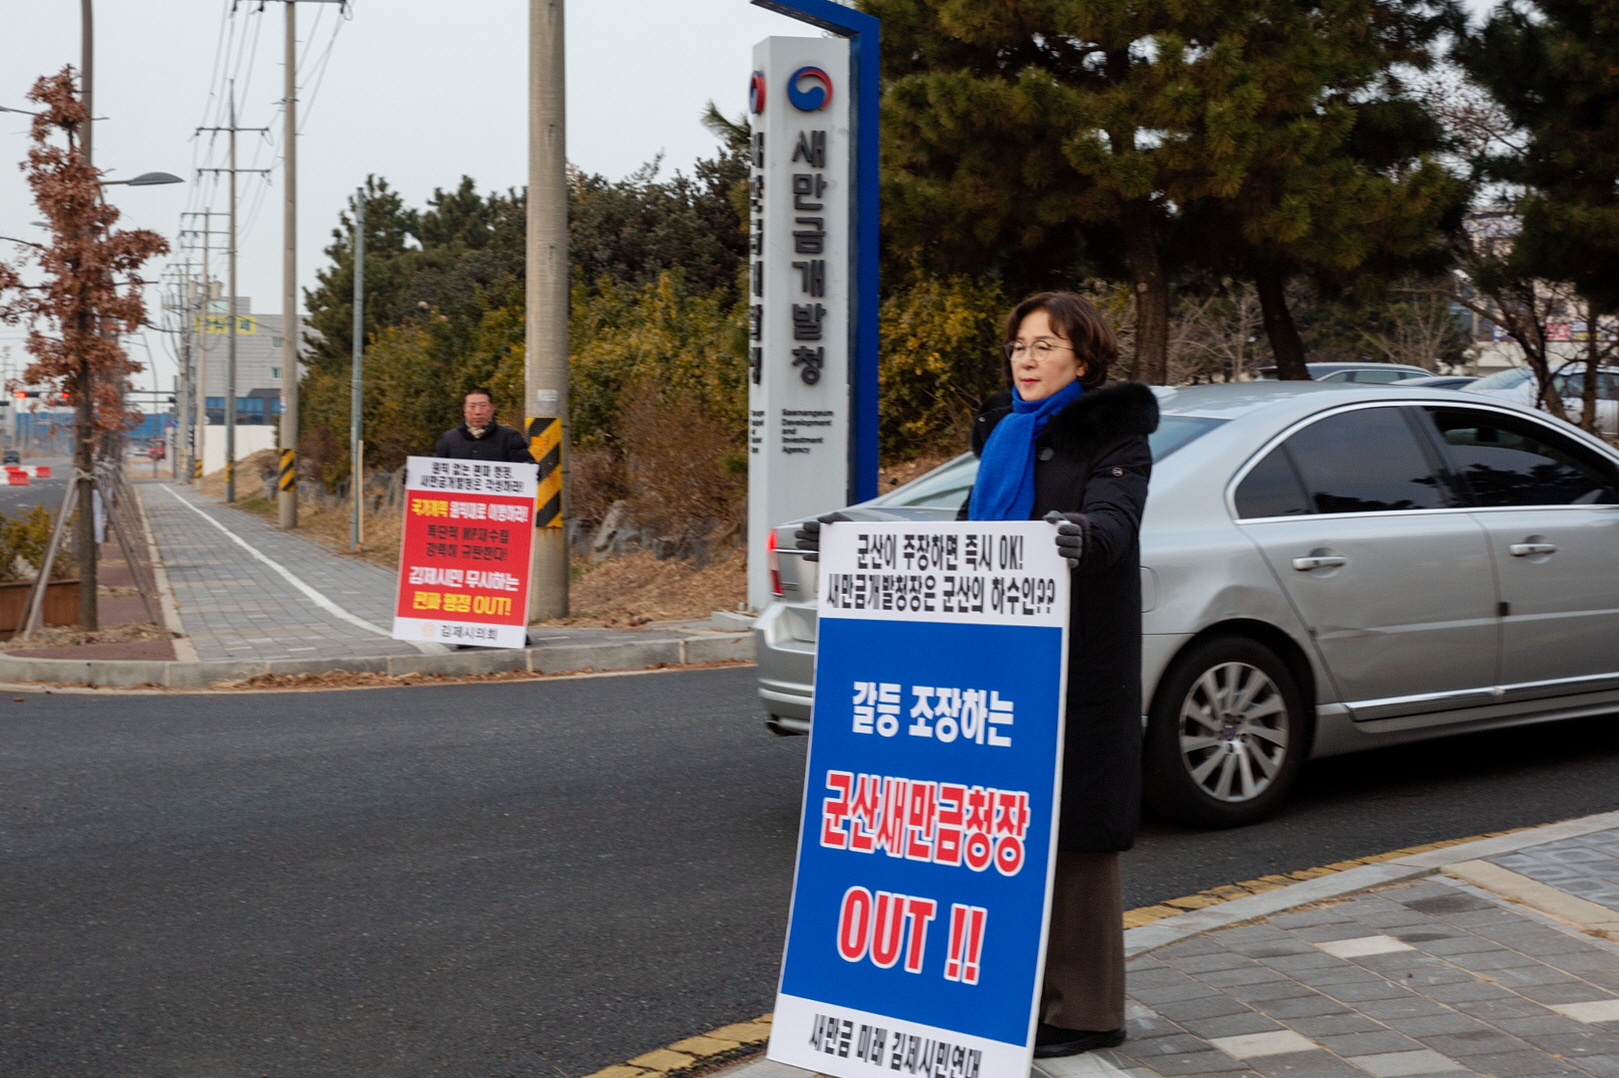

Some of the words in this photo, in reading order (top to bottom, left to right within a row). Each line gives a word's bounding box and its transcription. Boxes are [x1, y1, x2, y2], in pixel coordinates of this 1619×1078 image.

[791, 130, 827, 386] 새만금개발청
[782, 446, 811, 454] Agency
[857, 534, 897, 569] 군산이
[903, 534, 958, 571] 주장하면
[965, 535, 992, 571] 즉시
[999, 535, 1024, 570] OK!
[409, 566, 463, 587] 김제시민
[466, 571, 520, 591] 무시하는
[827, 574, 936, 612] 새만금개발청장은
[942, 576, 985, 614] 군산의
[991, 577, 1056, 615] 하수인??
[443, 593, 471, 612] 행정
[473, 596, 512, 615] OUT!
[441, 625, 498, 640] 김제시의회
[852, 681, 901, 738] 갈등
[909, 685, 1014, 747] 조장하는
[820, 769, 1031, 877] 군산새만금청장
[837, 886, 937, 974] OUT
[809, 1013, 855, 1058] 새만금
[857, 1025, 887, 1066] 미래
[890, 1032, 982, 1078] 김제시민연대
